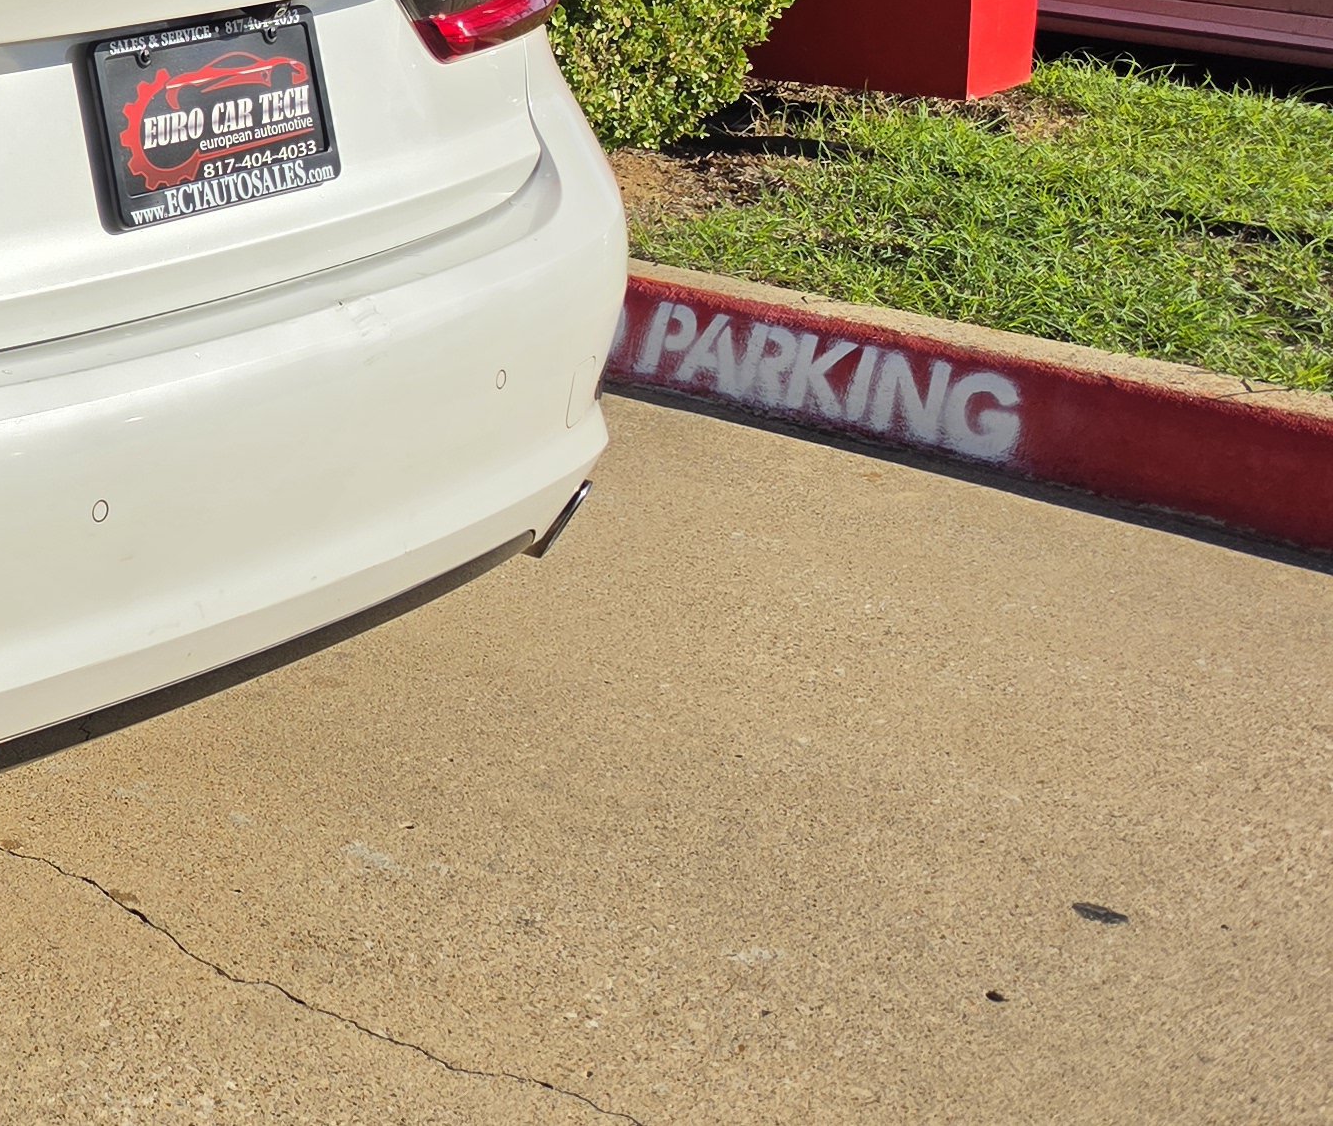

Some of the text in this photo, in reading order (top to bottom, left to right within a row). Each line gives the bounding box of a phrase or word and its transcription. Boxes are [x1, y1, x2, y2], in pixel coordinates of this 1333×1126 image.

[109, 39, 147, 54] SALES
[149, 34, 161, 49] &
[161, 25, 212, 46] SERVICE
[143, 85, 310, 150] EURO CAR TECH
[199, 116, 313, 151] european automotive
[203, 140, 317, 178] 817-404-4033
[131, 159, 335, 225] www.ECTAUTOSALES.com
[638, 302, 1023, 466] PARKING
